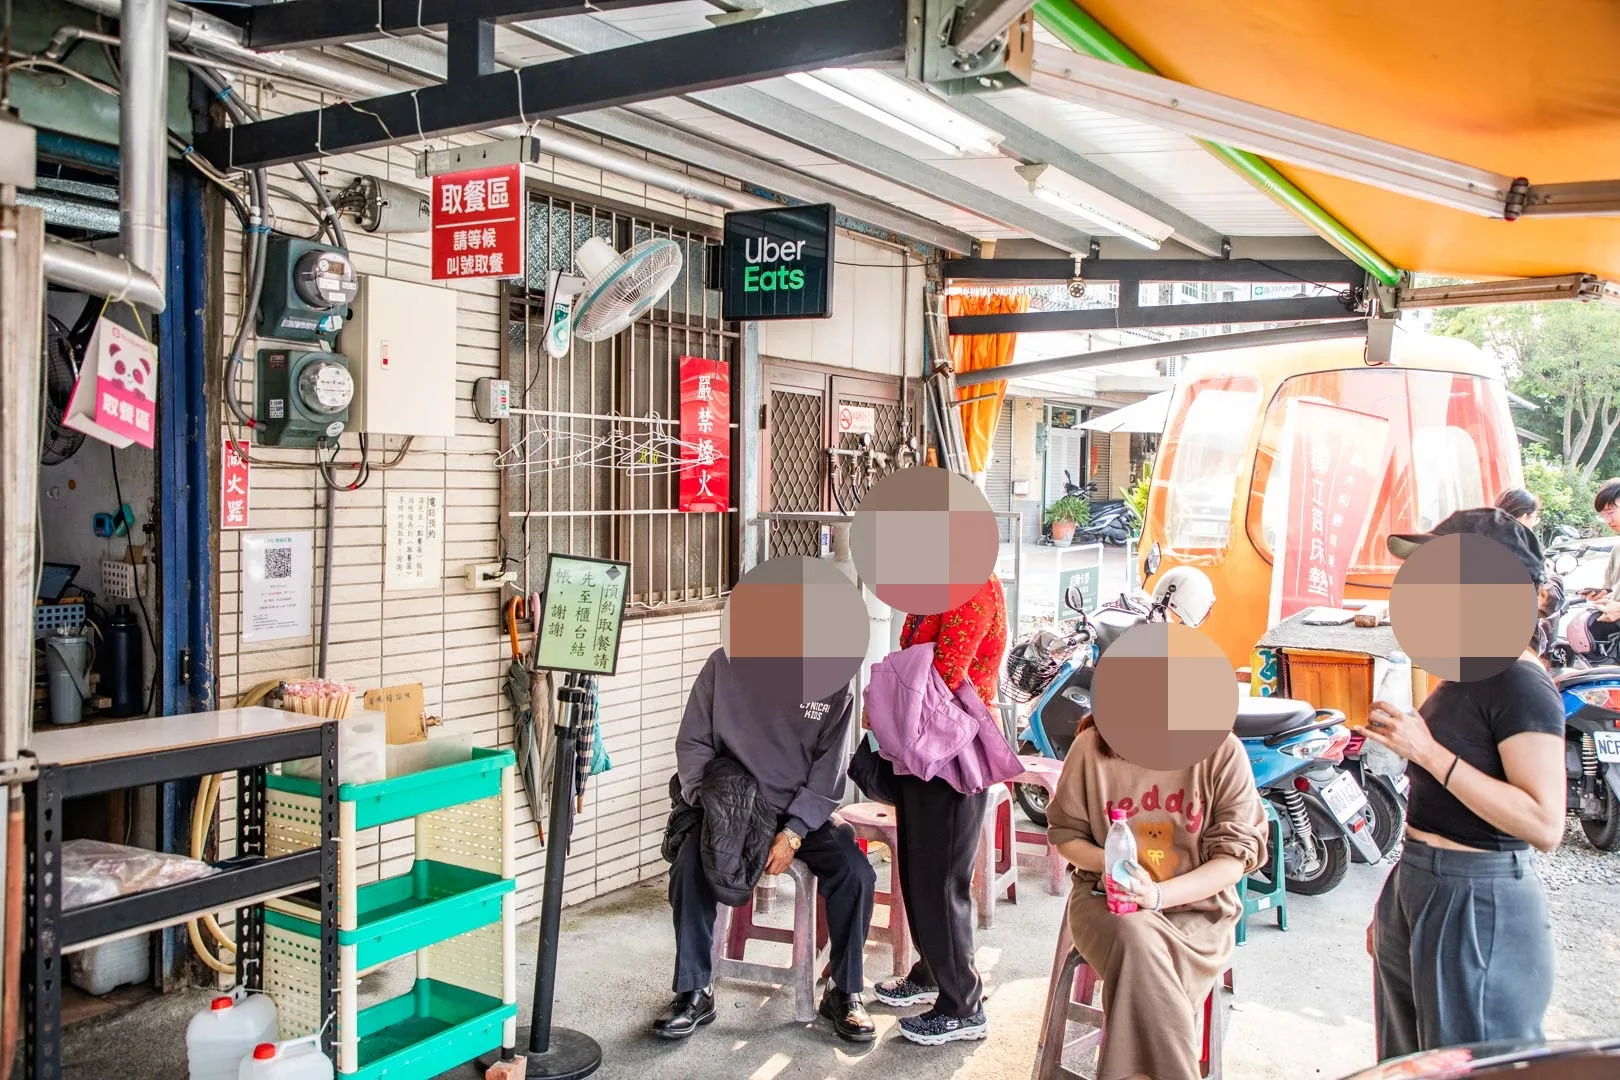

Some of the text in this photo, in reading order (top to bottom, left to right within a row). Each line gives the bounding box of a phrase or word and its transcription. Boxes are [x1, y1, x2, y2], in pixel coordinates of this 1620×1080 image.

[441, 176, 510, 214] 取餐區
[453, 228, 496, 251] 請等候
[745, 236, 806, 263] Uber
[447, 253, 503, 275] 叫號取餐
[744, 266, 805, 292] Eats
[102, 393, 150, 432] 取餐區
[696, 375, 714, 497] 嚴禁煙火
[226, 447, 247, 522] 滅火器
[569, 570, 596, 657] 先至櫃台結
[594, 584, 619, 669] 預約取餐請
[804, 709, 823, 721] KIDS
